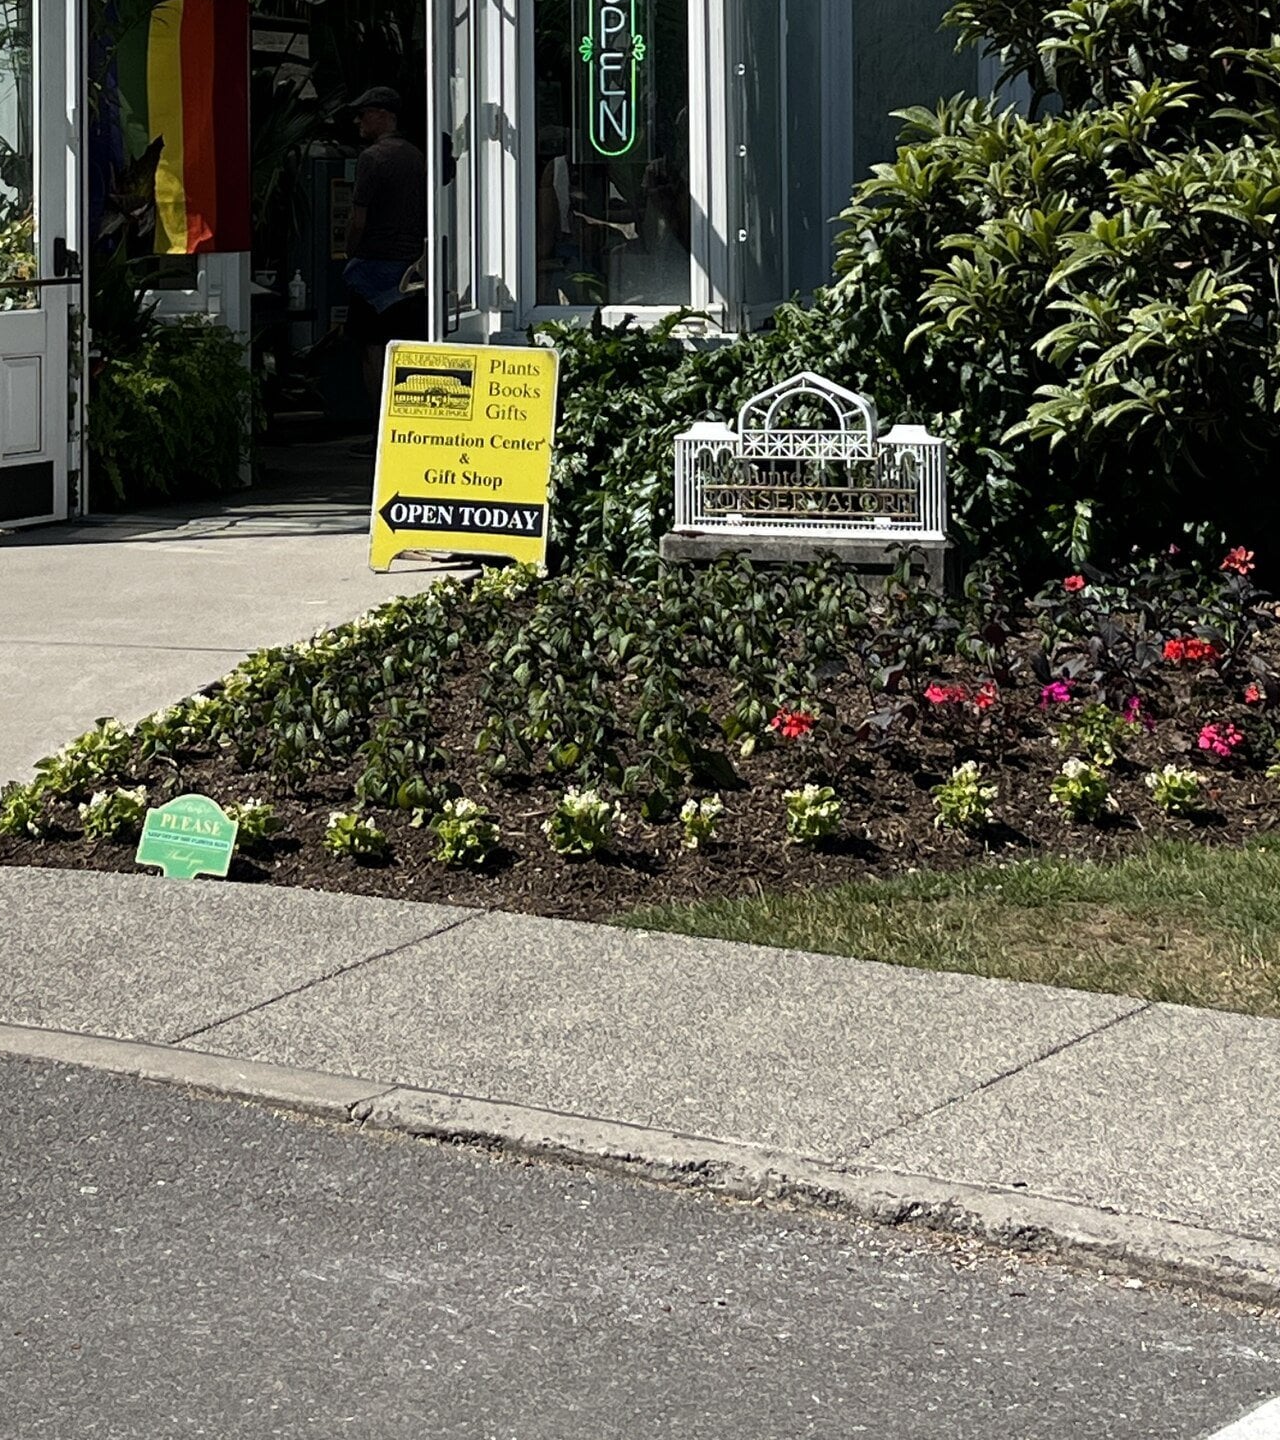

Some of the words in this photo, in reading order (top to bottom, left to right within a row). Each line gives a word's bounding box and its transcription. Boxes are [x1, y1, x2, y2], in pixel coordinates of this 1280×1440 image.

[489, 359, 541, 376] Plants
[488, 381, 541, 399] Books
[485, 403, 528, 421] Gifts
[390, 429, 485, 449] Information
[489, 434, 542, 452] Center
[458, 453, 470, 464] &
[424, 468, 457, 485] Gift
[460, 471, 503, 491] Shop
[389, 503, 454, 525] OPEN
[459, 506, 539, 530] TODAY
[160, 813, 223, 836] PLEASE
